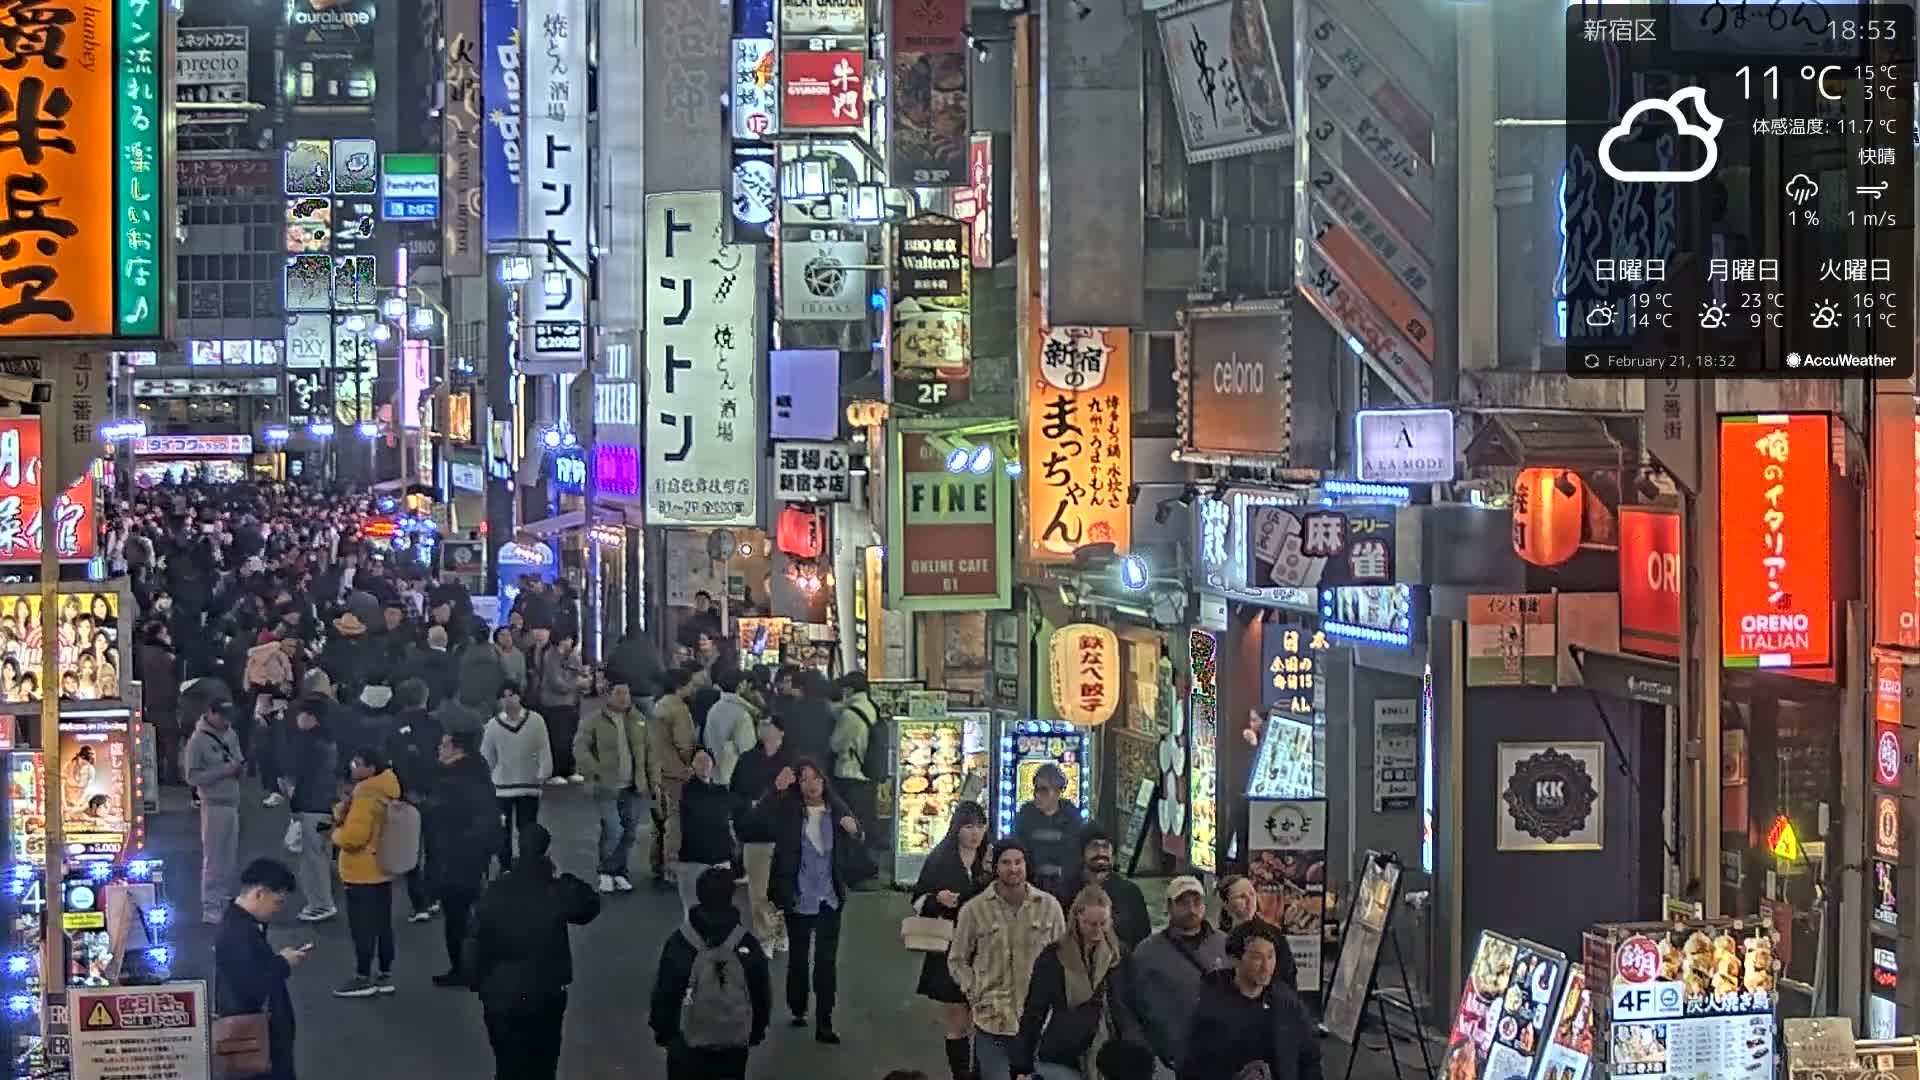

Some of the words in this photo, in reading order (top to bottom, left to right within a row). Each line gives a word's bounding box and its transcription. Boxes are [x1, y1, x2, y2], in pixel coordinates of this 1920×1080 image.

[902, 255, 961, 270] Walton's
[659, 208, 695, 461] トントン
[1212, 352, 1265, 394] celona
[917, 383, 948, 404] 2F
[780, 448, 845, 472] 酒場心
[1042, 394, 1087, 544] まっちゃん
[911, 484, 988, 513] FINE
[1350, 518, 1390, 534] フリー
[1755, 429, 1789, 603] 俺のイタリアン
[911, 559, 954, 574] ONLINE
[958, 558, 990, 574] CAFE
[1741, 615, 1809, 633] ORENO
[1740, 633, 1809, 650] ITALIAN
[1536, 781, 1564, 797] KK
[1618, 990, 1651, 1013] 4F
